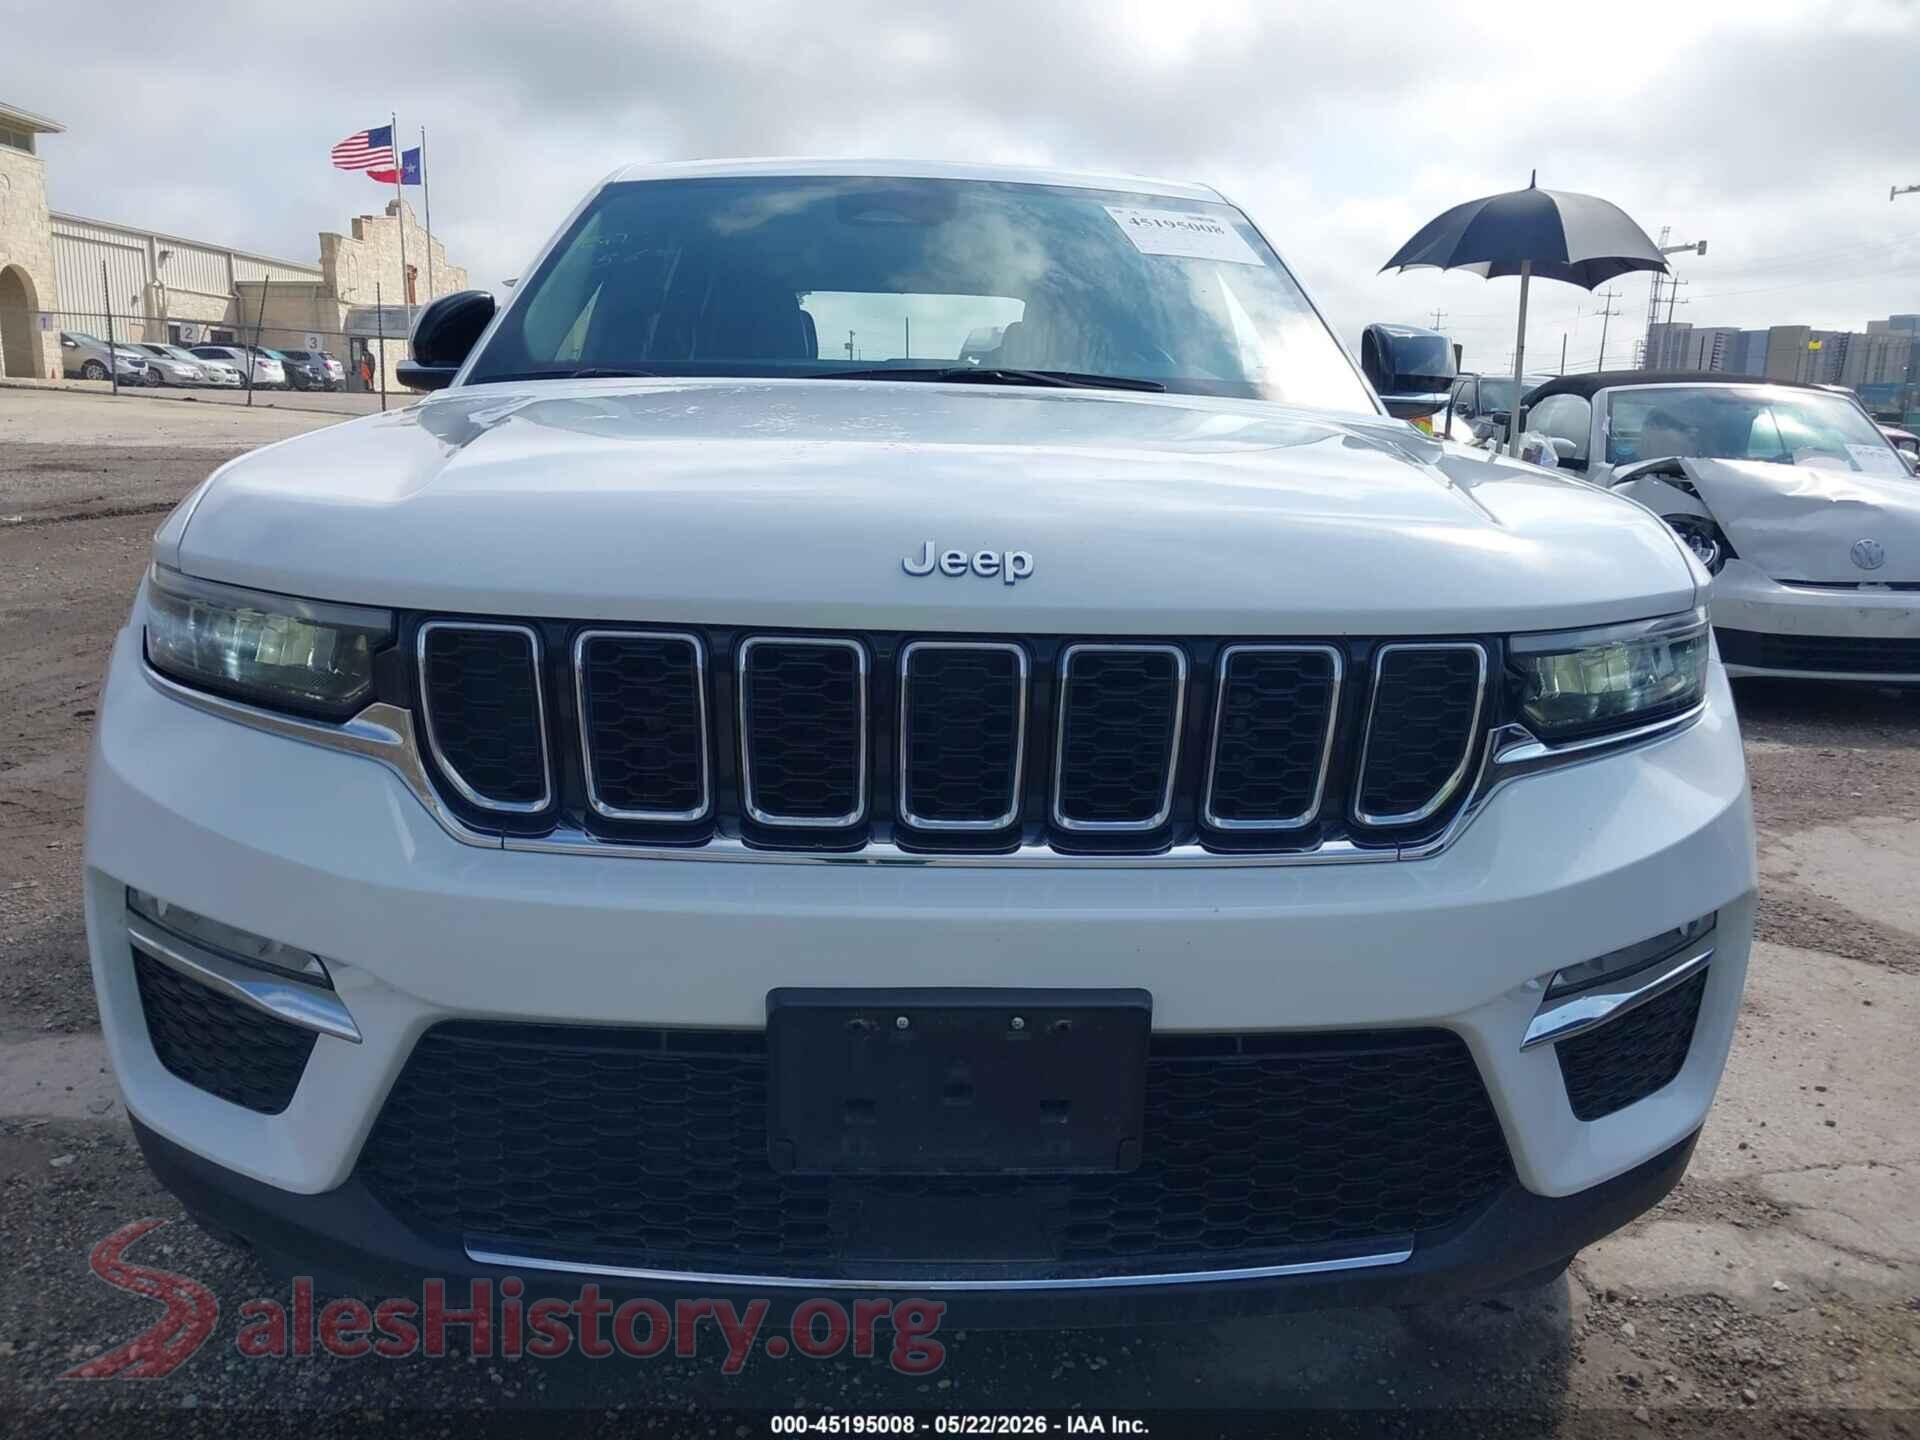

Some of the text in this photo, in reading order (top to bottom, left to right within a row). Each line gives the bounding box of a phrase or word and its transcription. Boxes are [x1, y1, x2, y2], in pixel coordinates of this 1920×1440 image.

[184, 327, 193, 340] 2
[309, 336, 318, 349] 3
[901, 539, 1034, 586] Jeep
